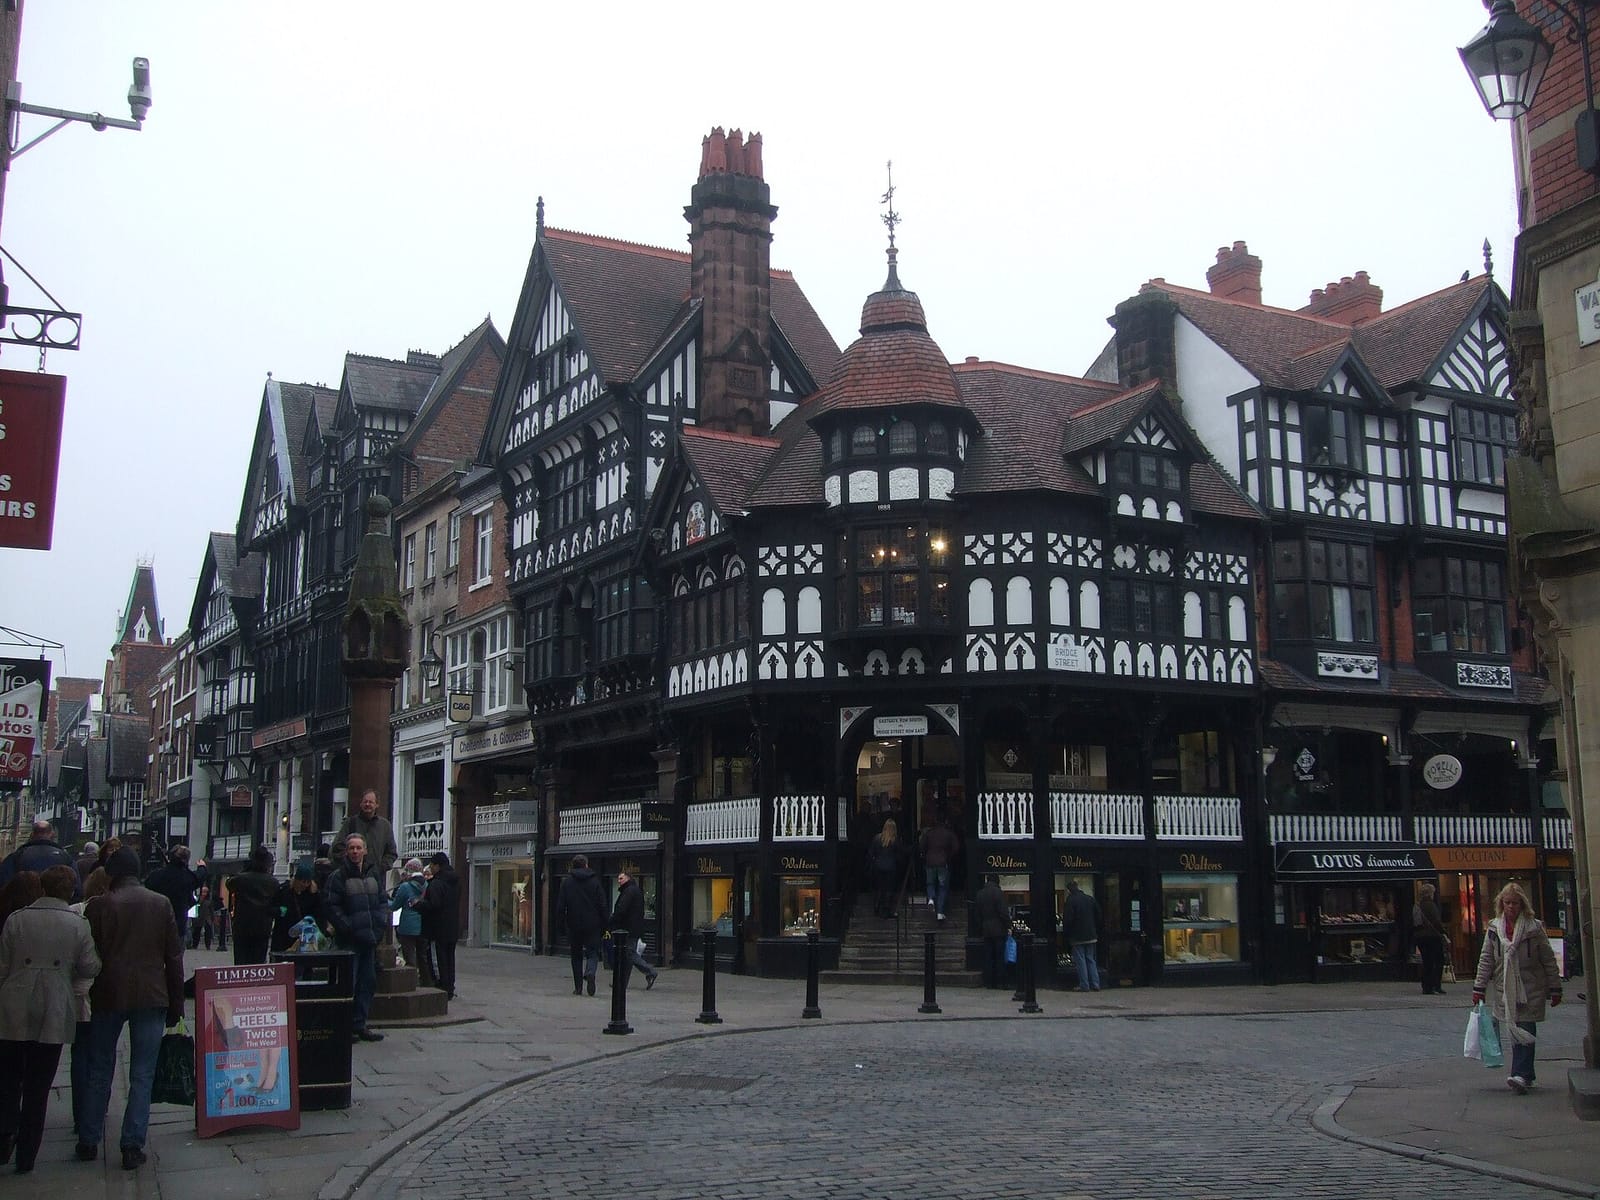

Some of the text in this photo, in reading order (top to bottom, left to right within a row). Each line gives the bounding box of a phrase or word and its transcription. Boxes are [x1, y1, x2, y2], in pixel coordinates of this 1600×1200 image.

[1580, 289, 1600, 311] WA
[1055, 648, 1079, 657] BRIDGE
[1055, 658, 1079, 667] STREET
[453, 702, 470, 711] C&G
[460, 728, 532, 753] Cheltenham & Gloucester
[697, 857, 722, 873] Waltons
[781, 856, 819, 869] Waltons
[986, 855, 1027, 868] Waltons
[1060, 855, 1093, 868] Waltons
[1180, 853, 1223, 870] Waltons
[1312, 854, 1415, 869] LOTUS diamonds
[215, 967, 276, 980] TIMPSON
[240, 995, 271, 1003] TIMPSON
[239, 1014, 277, 1027] HEELS
[245, 1028, 277, 1040] Twice
[260, 1039, 277, 1047] Wear
